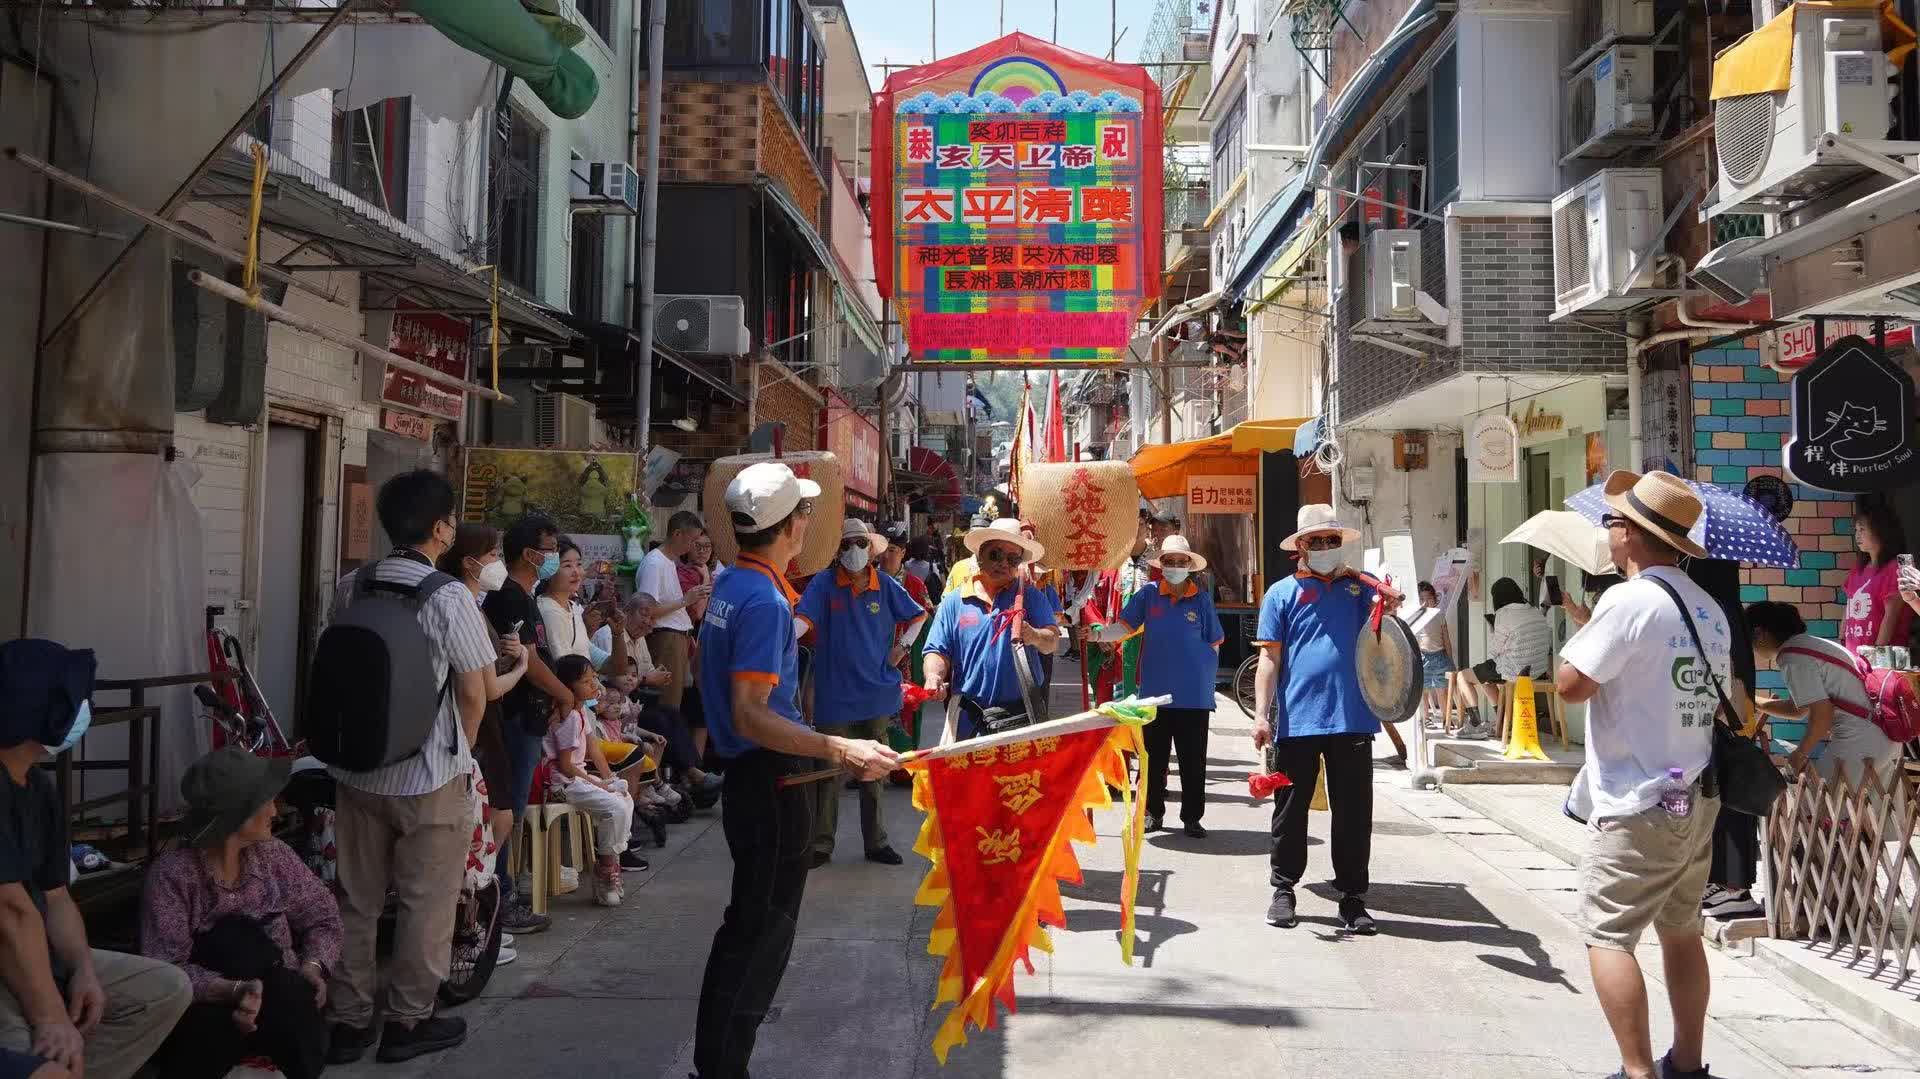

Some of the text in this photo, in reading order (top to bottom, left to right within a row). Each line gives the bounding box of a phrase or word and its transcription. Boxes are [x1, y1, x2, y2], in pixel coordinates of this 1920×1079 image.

[970, 121, 1065, 140] 癸卯吉祥
[908, 128, 932, 160] 恭
[1103, 127, 1126, 158] 祝
[938, 145, 1094, 168] 玄天上帝
[903, 188, 1132, 222] 太平清醮
[919, 246, 1120, 264] 神光普照 共沐神恩
[945, 270, 1066, 289] 長洲惠潮府
[1894, 447, 1914, 464] Soul
[1191, 486, 1219, 505] 自力
